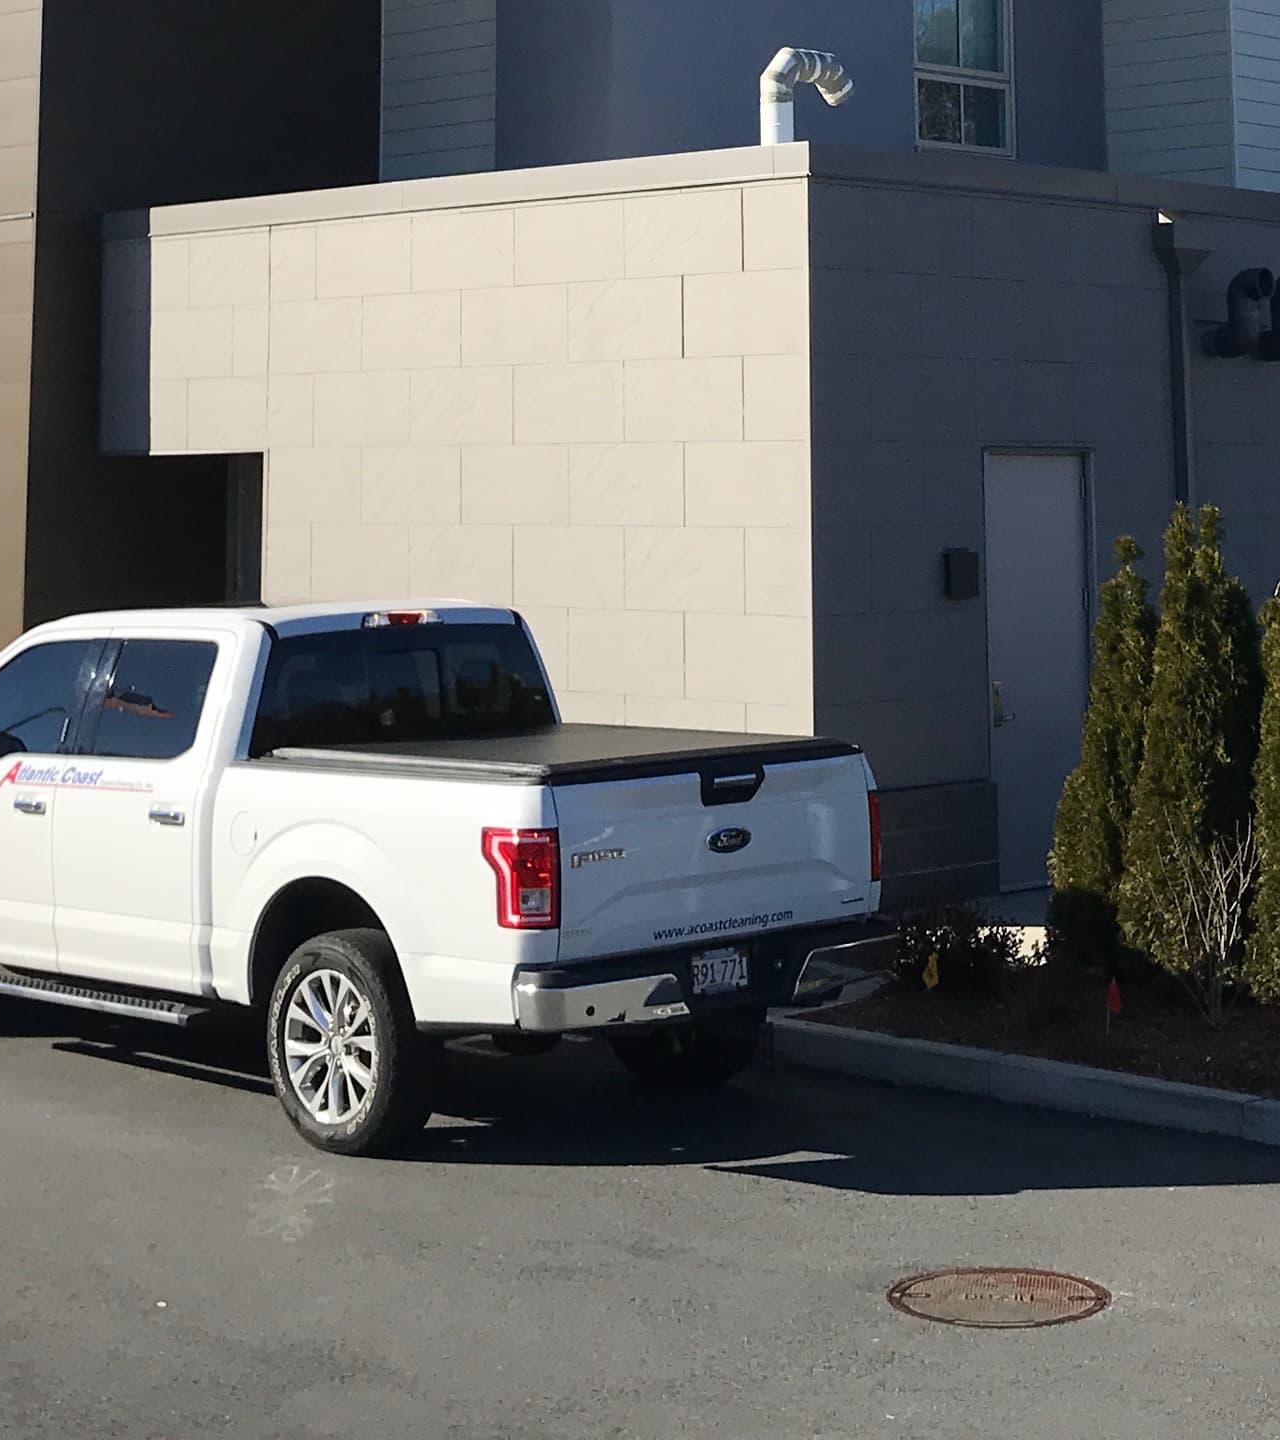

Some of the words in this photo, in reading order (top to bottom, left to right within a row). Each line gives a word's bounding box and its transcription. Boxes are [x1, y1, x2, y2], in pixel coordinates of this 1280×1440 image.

[61, 766, 104, 785] Coast
[652, 910, 793, 940] www.acoastcleaning.com
[721, 959, 746, 982] 771
